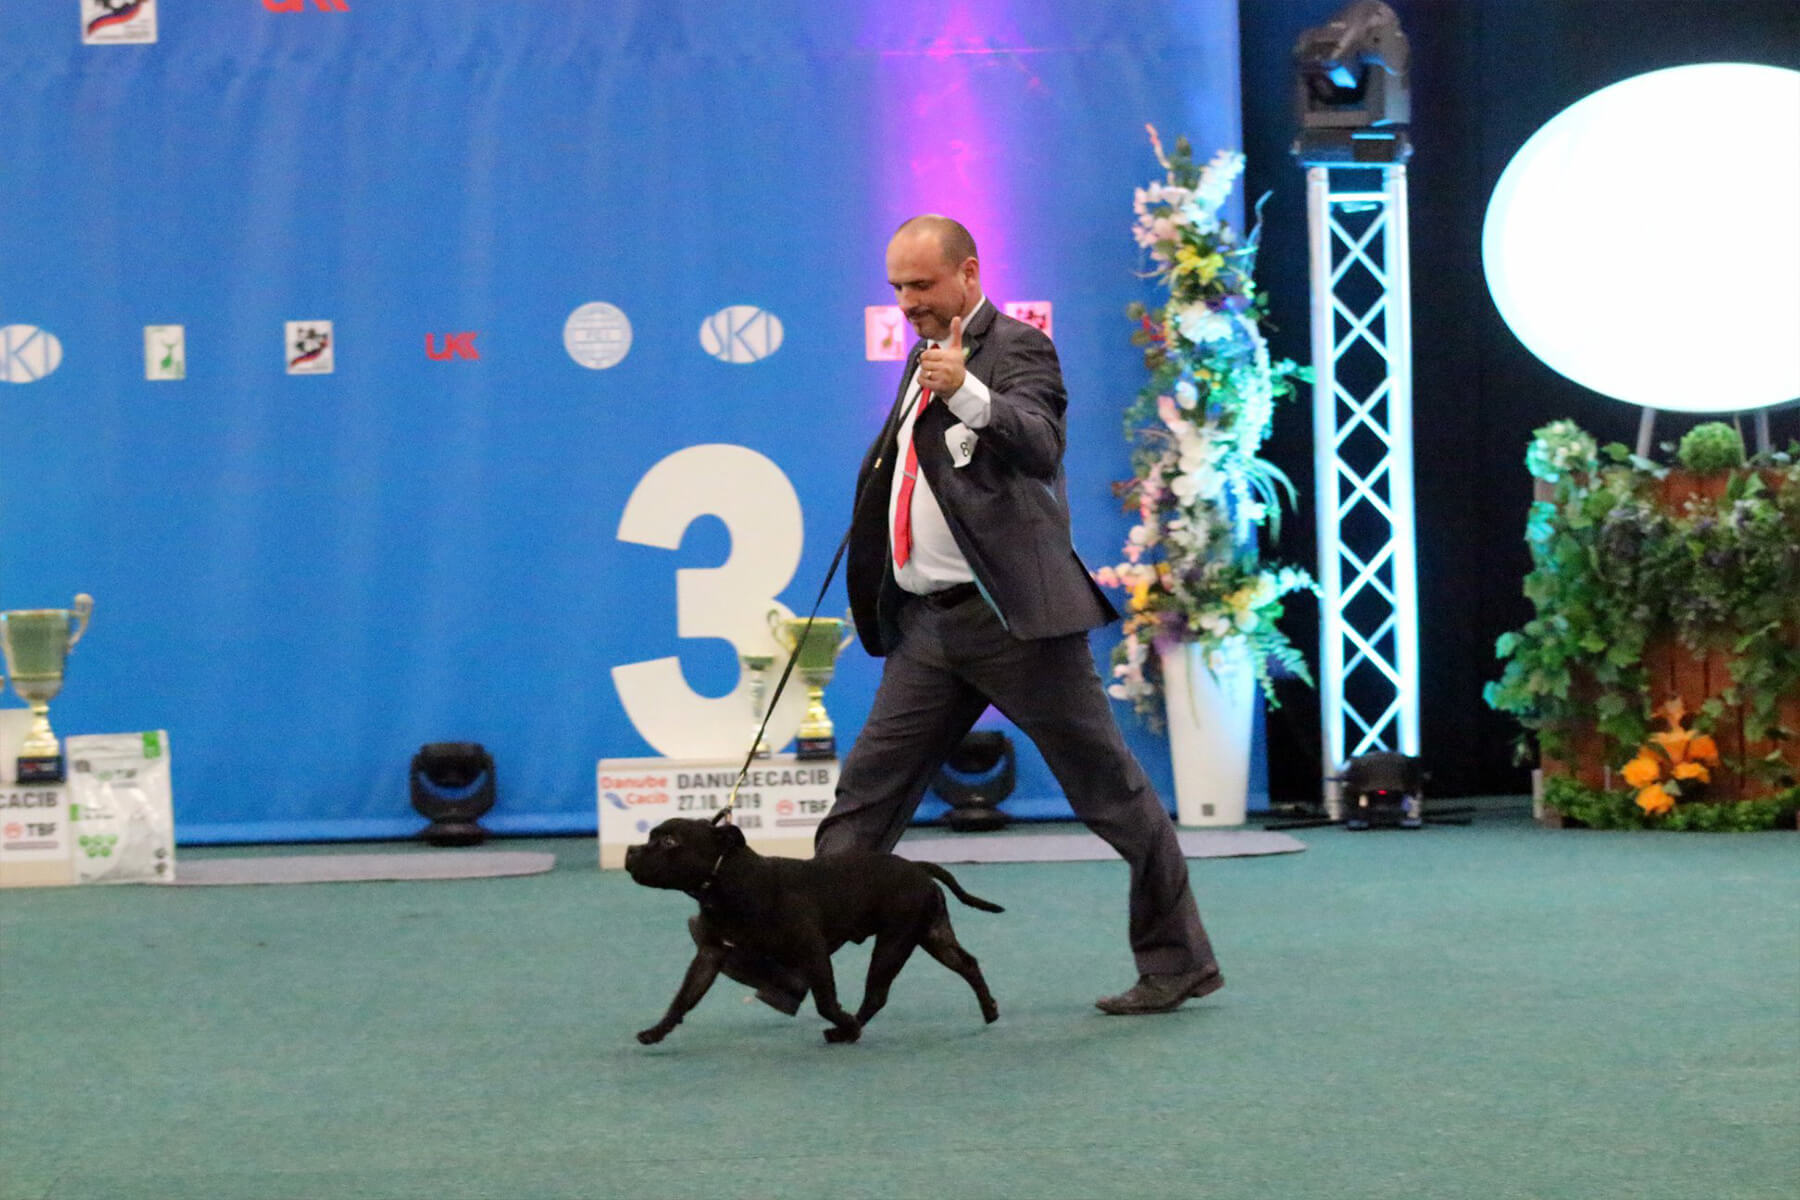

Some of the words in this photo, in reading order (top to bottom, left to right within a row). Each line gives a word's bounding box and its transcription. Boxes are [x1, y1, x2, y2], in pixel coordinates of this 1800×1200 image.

[610, 443, 805, 760] 3
[600, 776, 668, 790] Danube
[677, 769, 830, 790] DANUBECACIB
